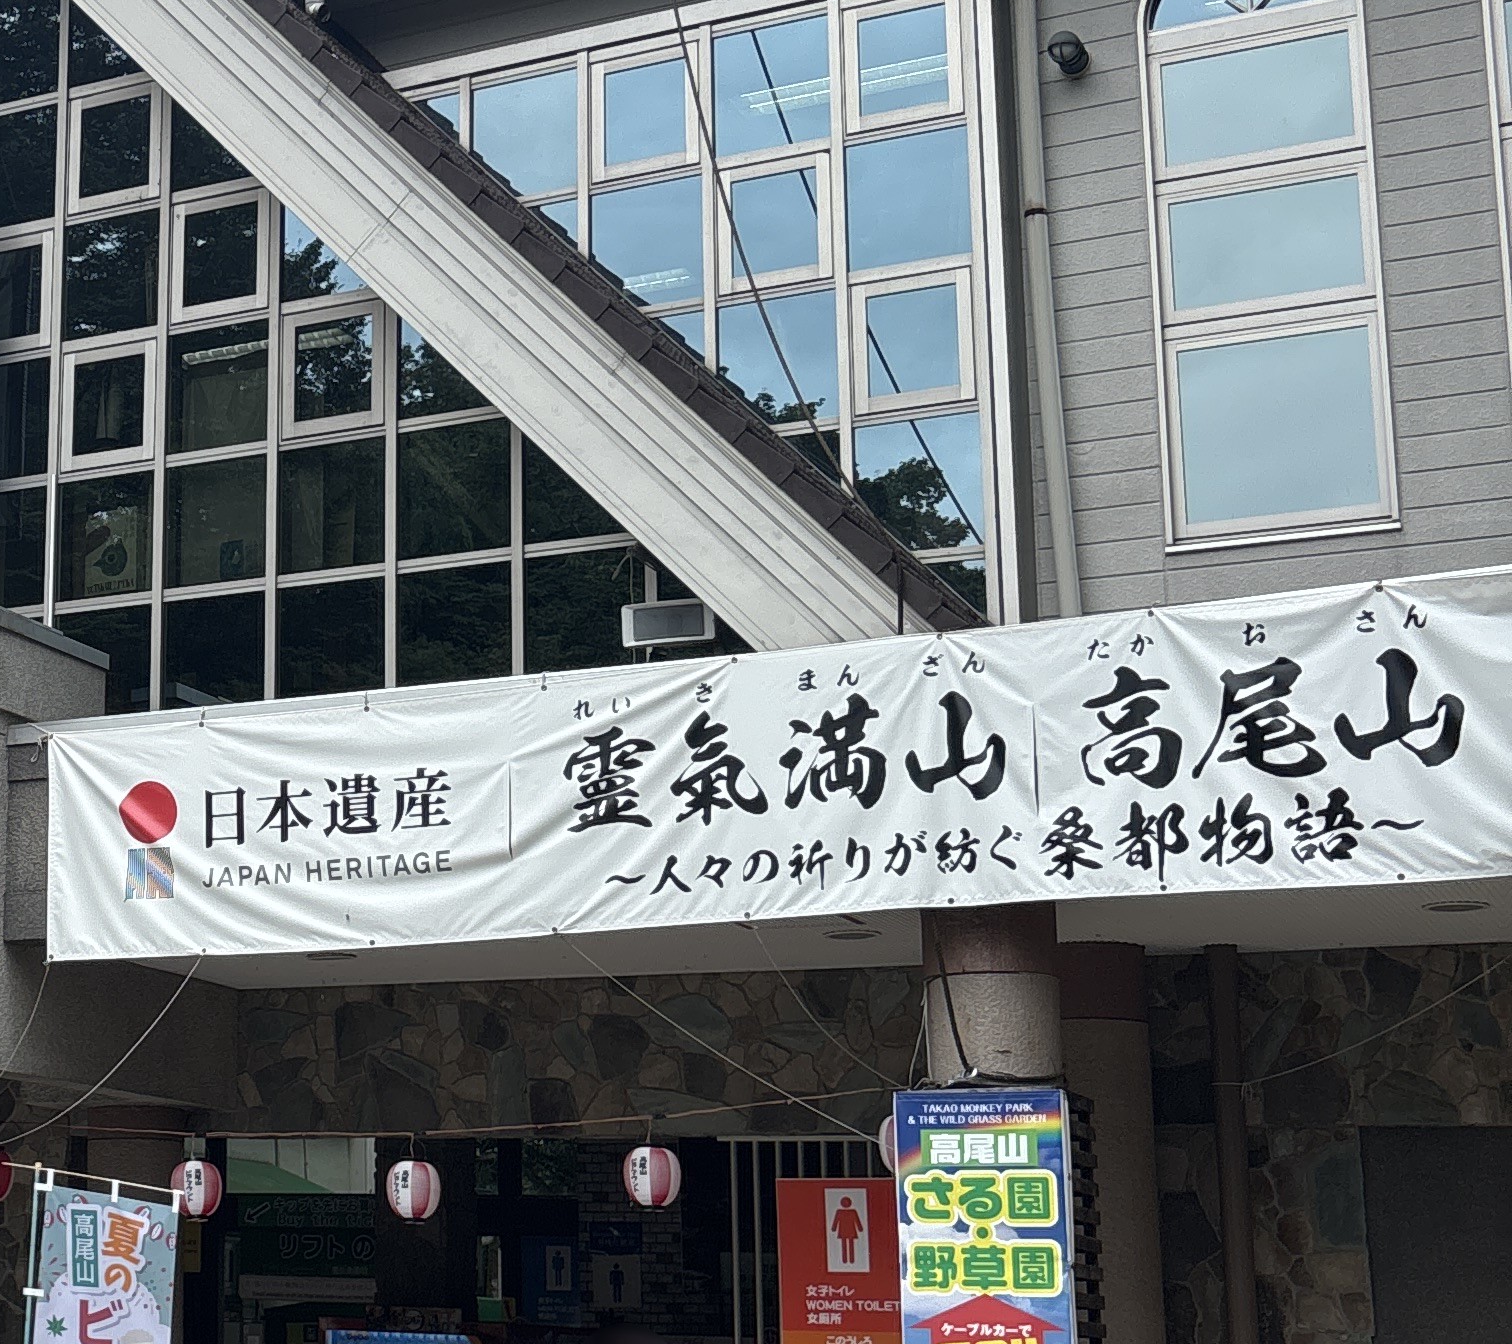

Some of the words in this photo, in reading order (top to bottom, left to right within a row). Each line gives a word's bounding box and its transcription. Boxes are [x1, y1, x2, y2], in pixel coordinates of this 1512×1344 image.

[1081, 648, 1466, 789] 高尾山
[205, 767, 452, 849] 日本遺産
[202, 862, 291, 889] JAPAN
[305, 849, 453, 883] HERITAGE
[918, 1115, 937, 1124] THE
[940, 1115, 965, 1124] WILD
[968, 1114, 1002, 1124] GRASS
[1005, 1113, 1047, 1123] GARDEN
[922, 1104, 958, 1113] TAKAO
[960, 1103, 1003, 1113] MONKEY
[1005, 1103, 1034, 1112] PARK
[929, 1133, 1028, 1164] 高尾山
[911, 1177, 1051, 1220] さる園
[74, 1213, 95, 1284] 高尾山
[102, 1211, 145, 1292] 夏の
[913, 1244, 1055, 1290] 野草園
[806, 1284, 855, 1297] 女子トイレ
[806, 1299, 853, 1311] WOMEN
[855, 1300, 900, 1312] TOILET
[941, 1322, 1032, 1337] ケーブルカーで
